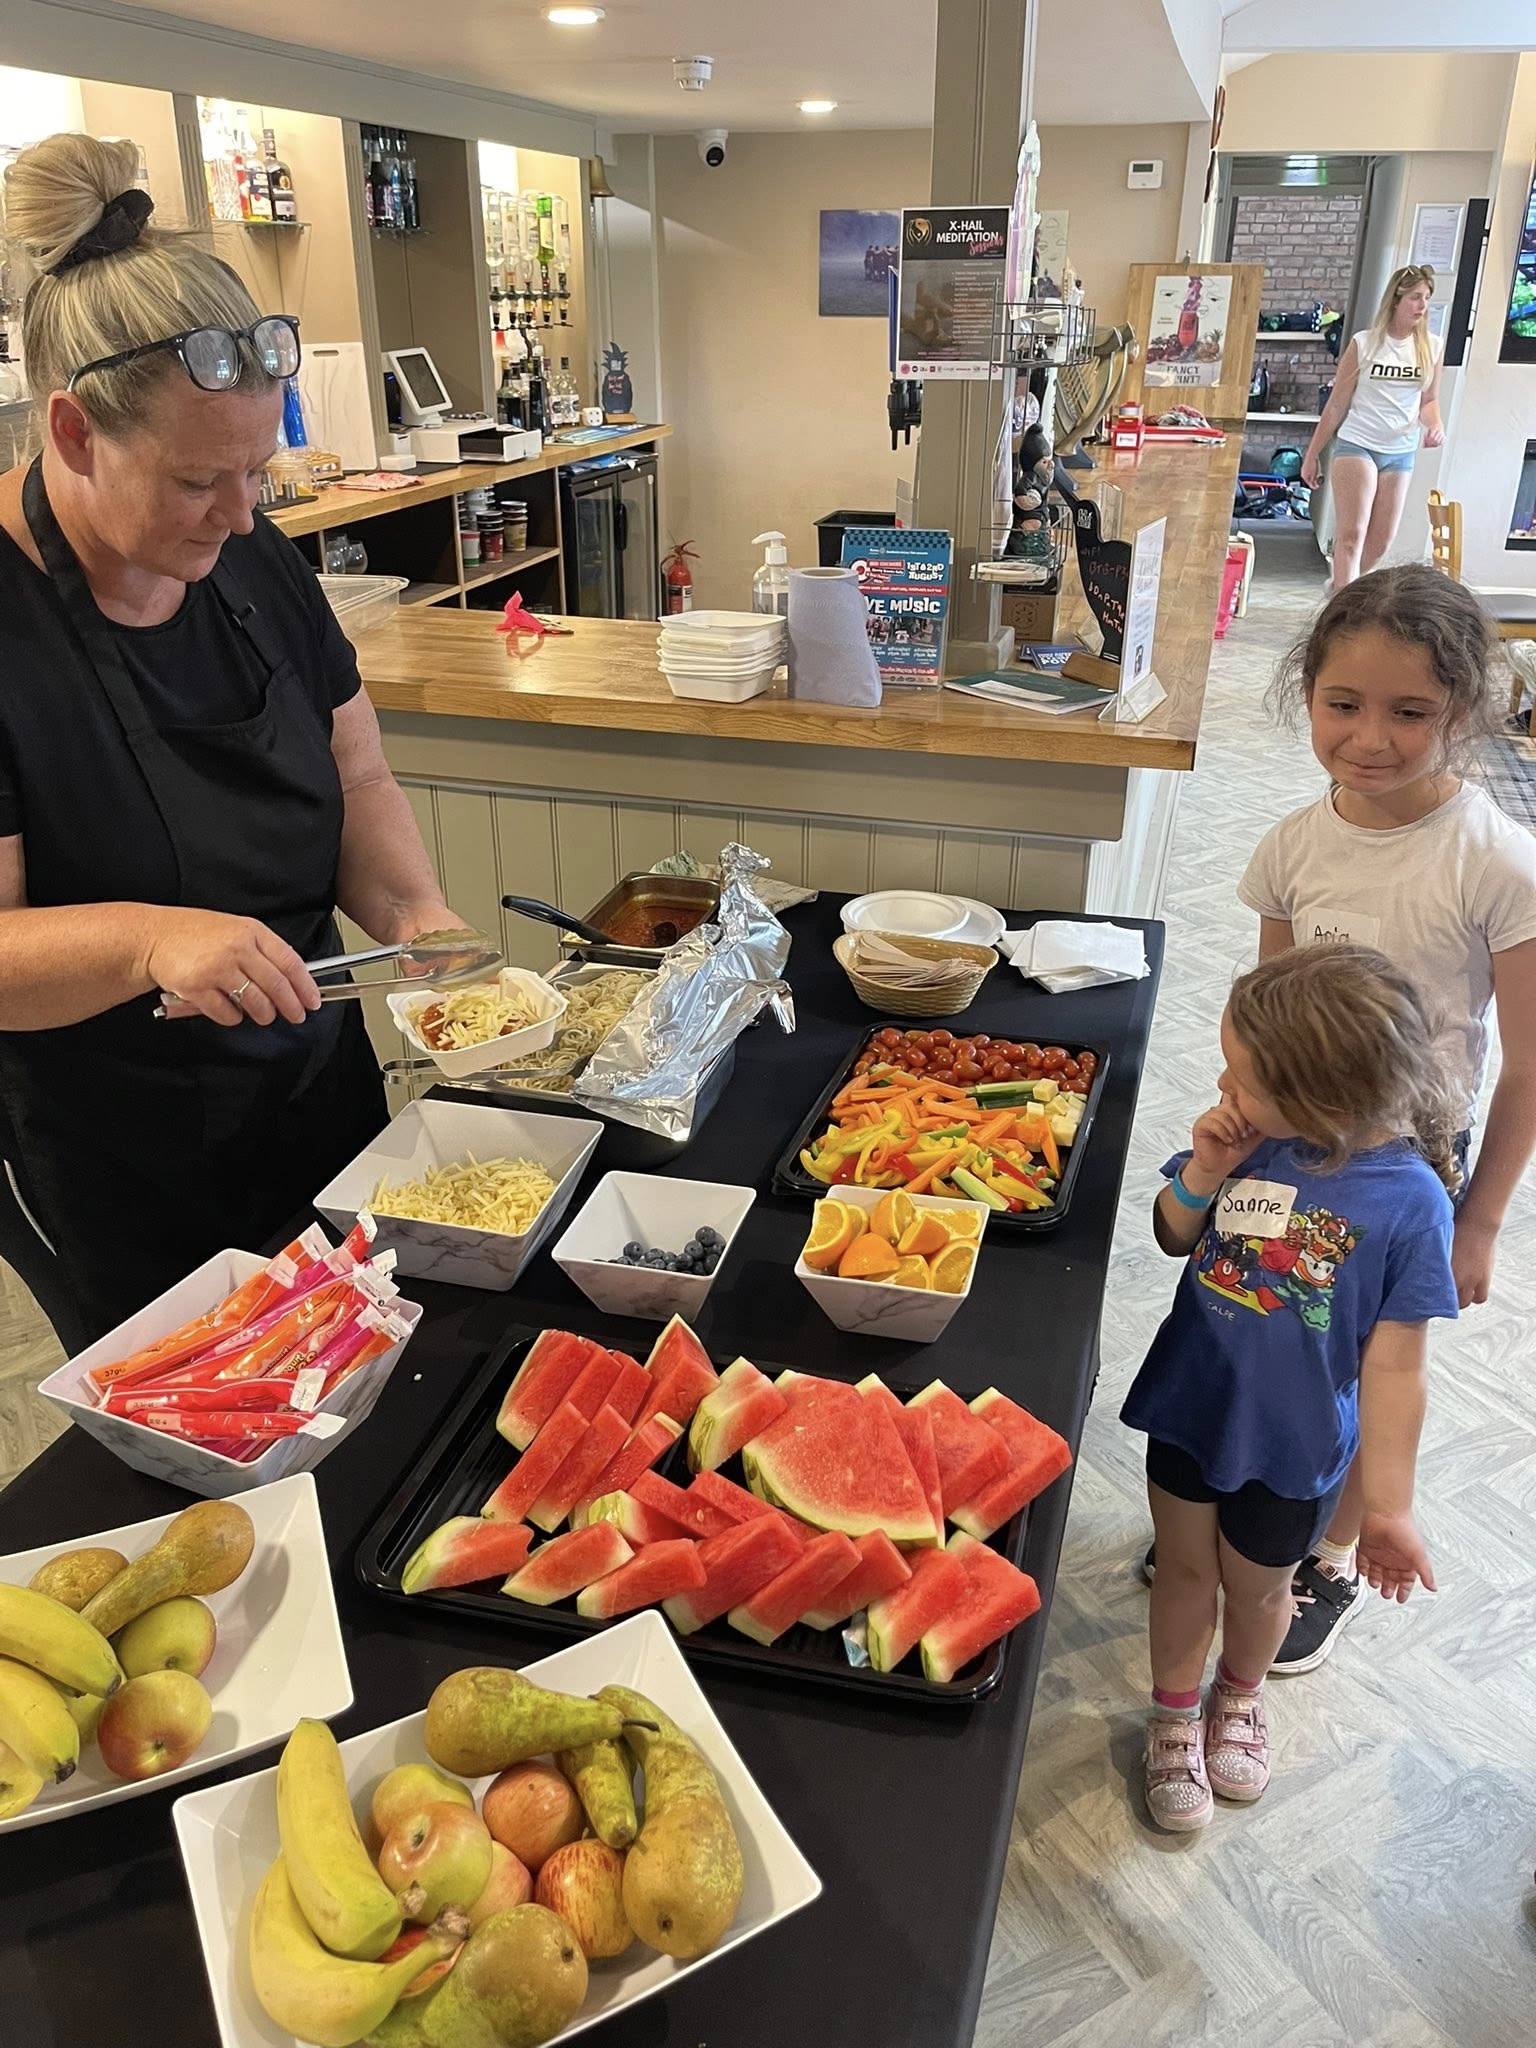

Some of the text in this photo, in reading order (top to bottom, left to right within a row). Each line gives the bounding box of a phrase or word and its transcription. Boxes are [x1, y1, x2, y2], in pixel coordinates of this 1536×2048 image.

[949, 220, 984, 232] X-HAIL
[936, 231, 999, 243] MEDITATION
[969, 236, 1005, 256] Sessions
[1166, 365, 1199, 375] FANCY
[908, 571, 944, 581] AUGUST
[864, 595, 941, 615] VE MUSIC
[1223, 1190, 1285, 1215] Sanne
